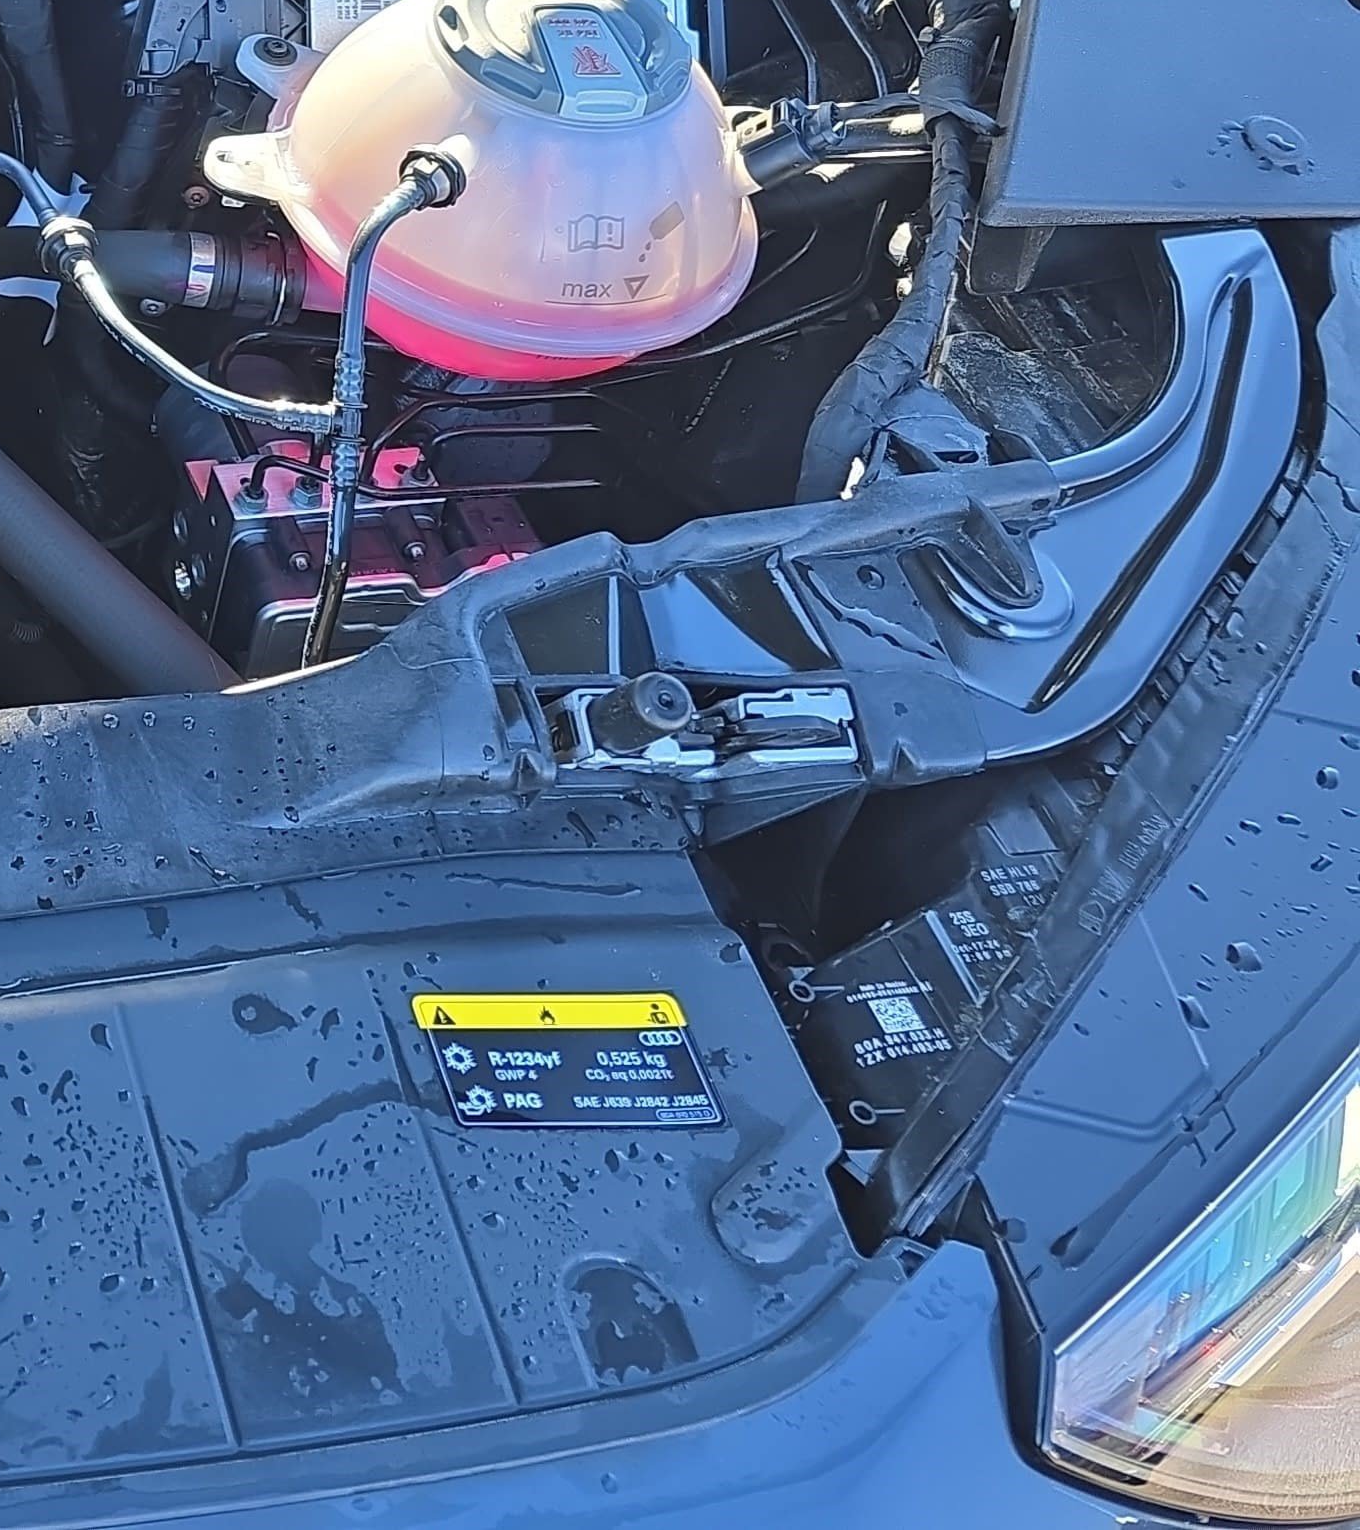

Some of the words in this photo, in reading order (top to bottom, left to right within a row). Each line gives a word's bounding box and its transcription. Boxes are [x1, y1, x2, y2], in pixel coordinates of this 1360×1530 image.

[561, 282, 612, 299] max
[980, 867, 1007, 881] SAE
[989, 882, 1016, 896] SSB
[948, 911, 976, 927] 25S
[487, 1050, 563, 1070] R-1234yf
[596, 1050, 642, 1068] 0,525
[642, 1050, 668, 1070] kg
[494, 1070, 527, 1082] GWP
[527, 1070, 539, 1082] 4
[502, 1092, 544, 1110] PAG
[573, 1095, 602, 1108] SAE
